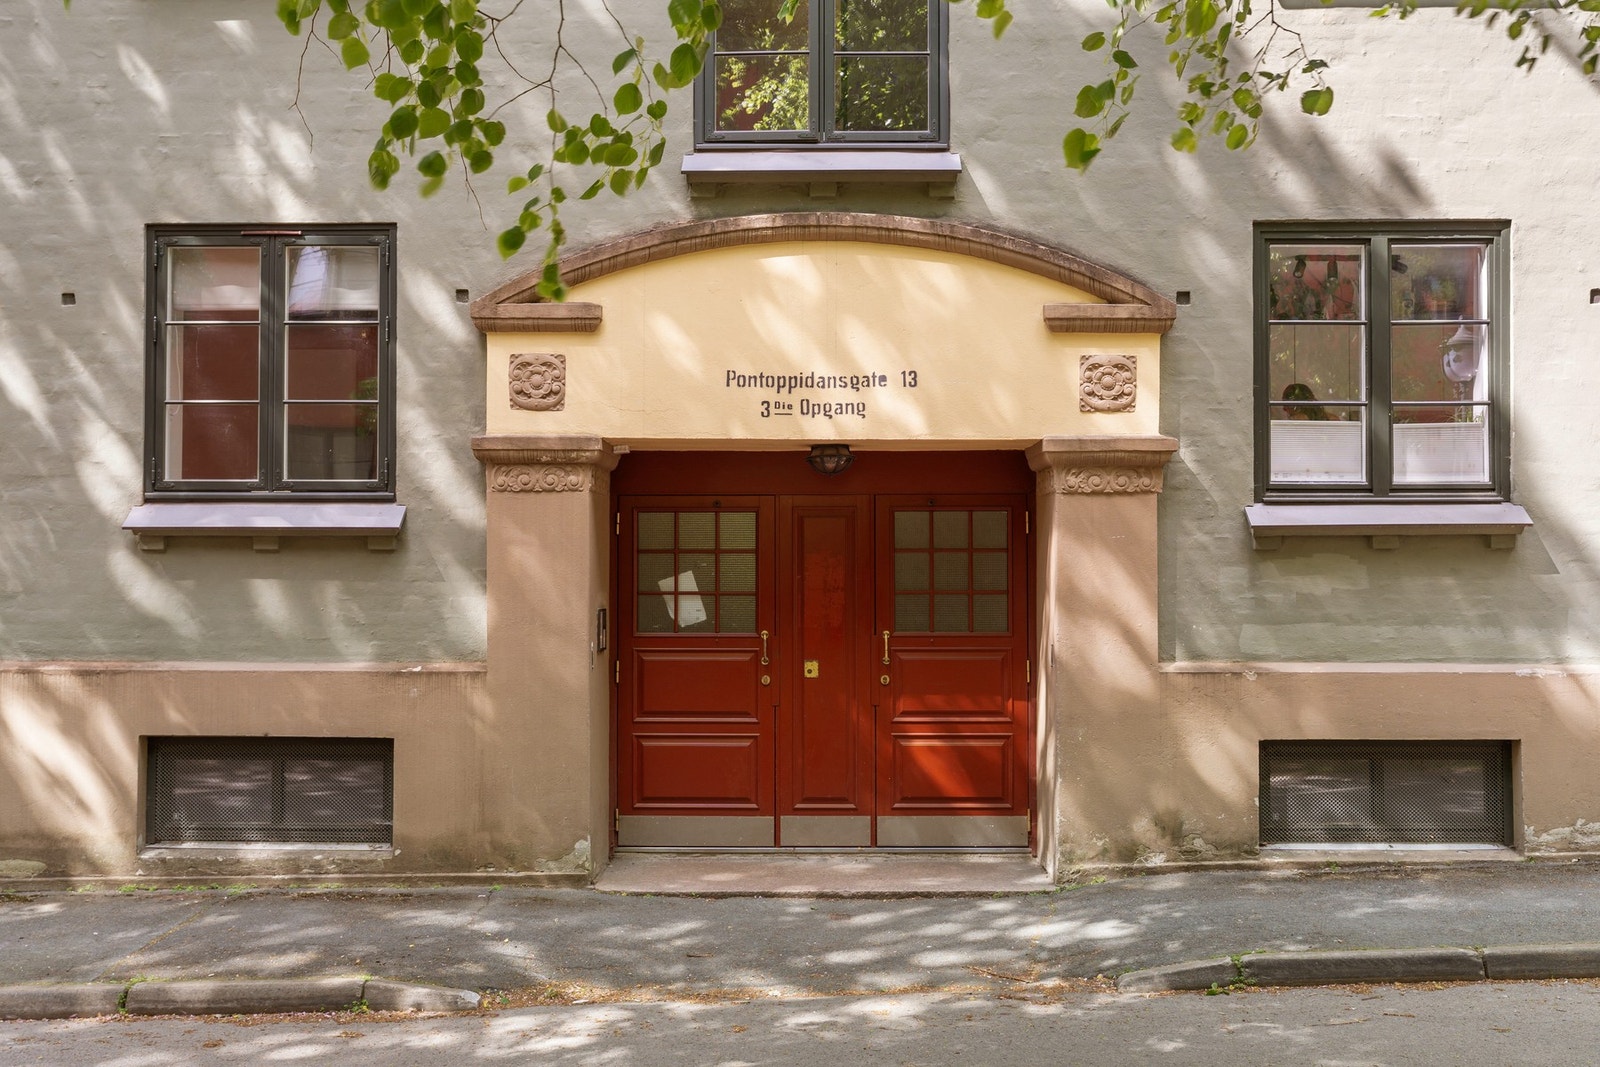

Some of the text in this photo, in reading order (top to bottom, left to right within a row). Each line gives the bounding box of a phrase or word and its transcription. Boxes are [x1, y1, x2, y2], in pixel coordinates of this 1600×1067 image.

[726, 370, 918, 394] Pontoppidansgate 13
[800, 398, 866, 419] Opgang
